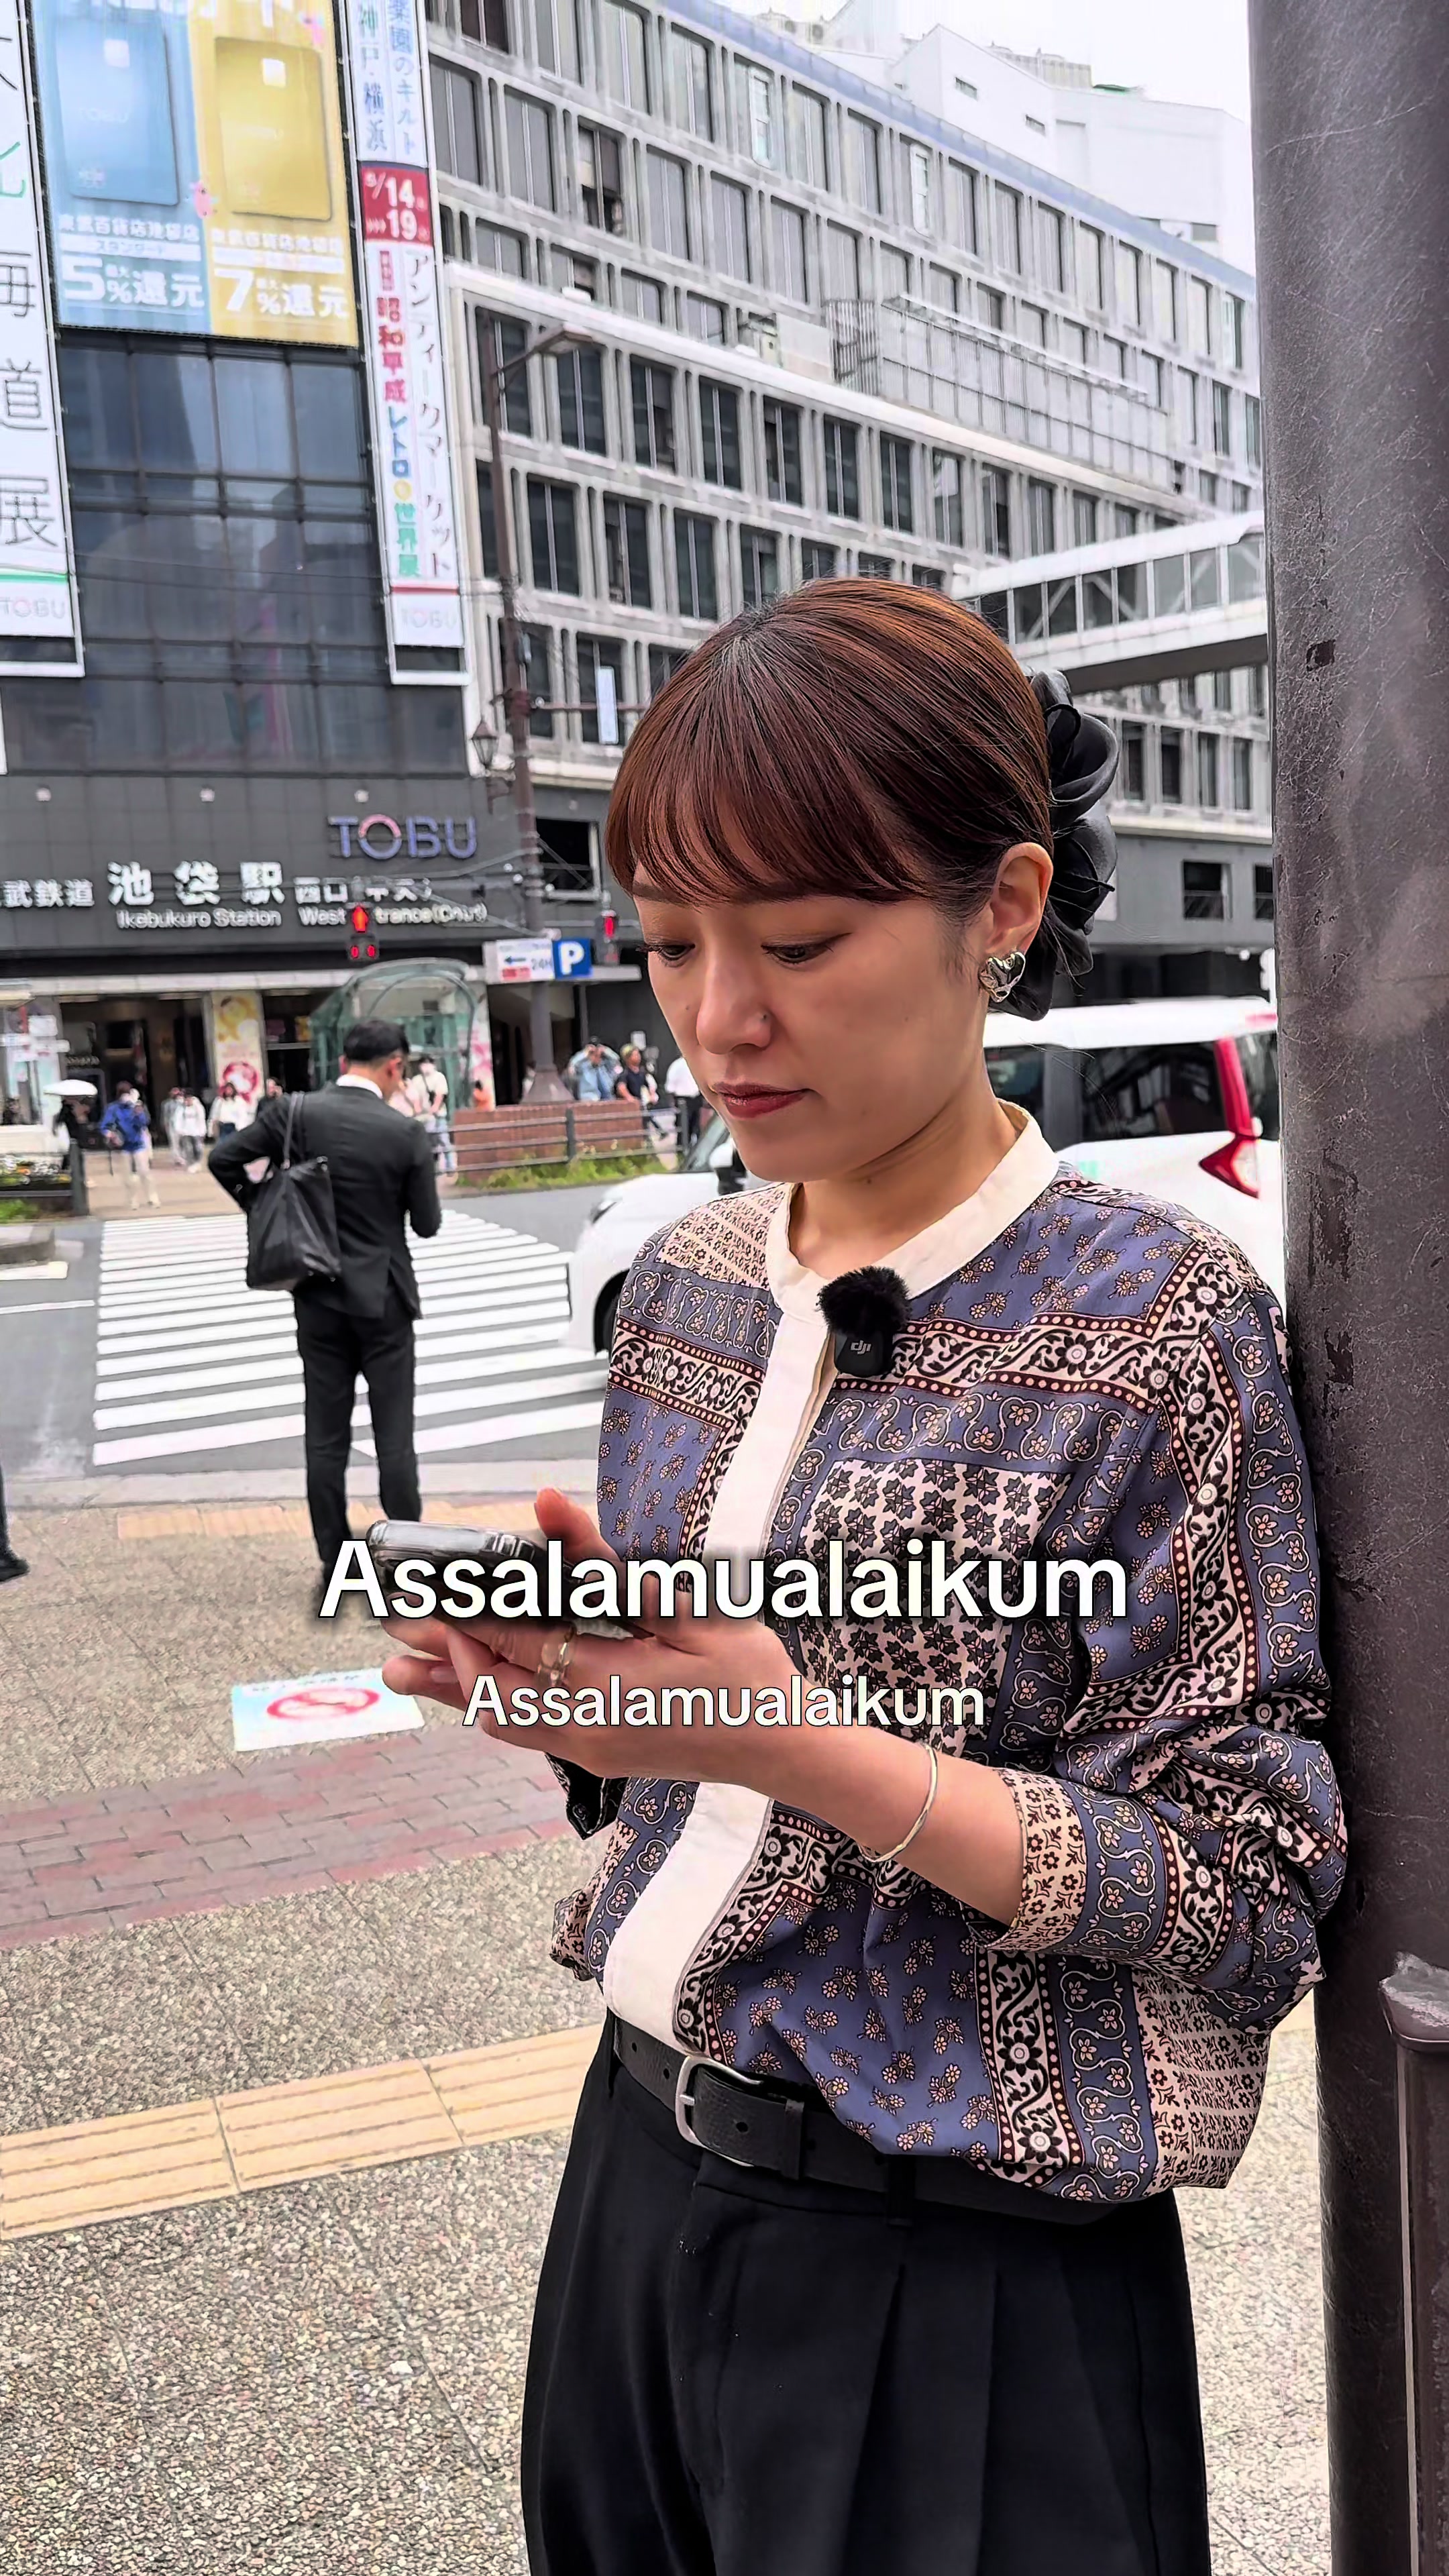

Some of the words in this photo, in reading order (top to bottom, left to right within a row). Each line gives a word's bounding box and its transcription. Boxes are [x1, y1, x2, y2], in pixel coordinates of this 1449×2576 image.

[328, 814, 478, 859] TOBU
[0, 878, 95, 908] 武鉄道
[108, 861, 285, 906] 池袋駅
[116, 908, 211, 929] Ikebukuro
[213, 908, 282, 928] Station
[298, 906, 346, 926] West
[558, 941, 584, 975] P
